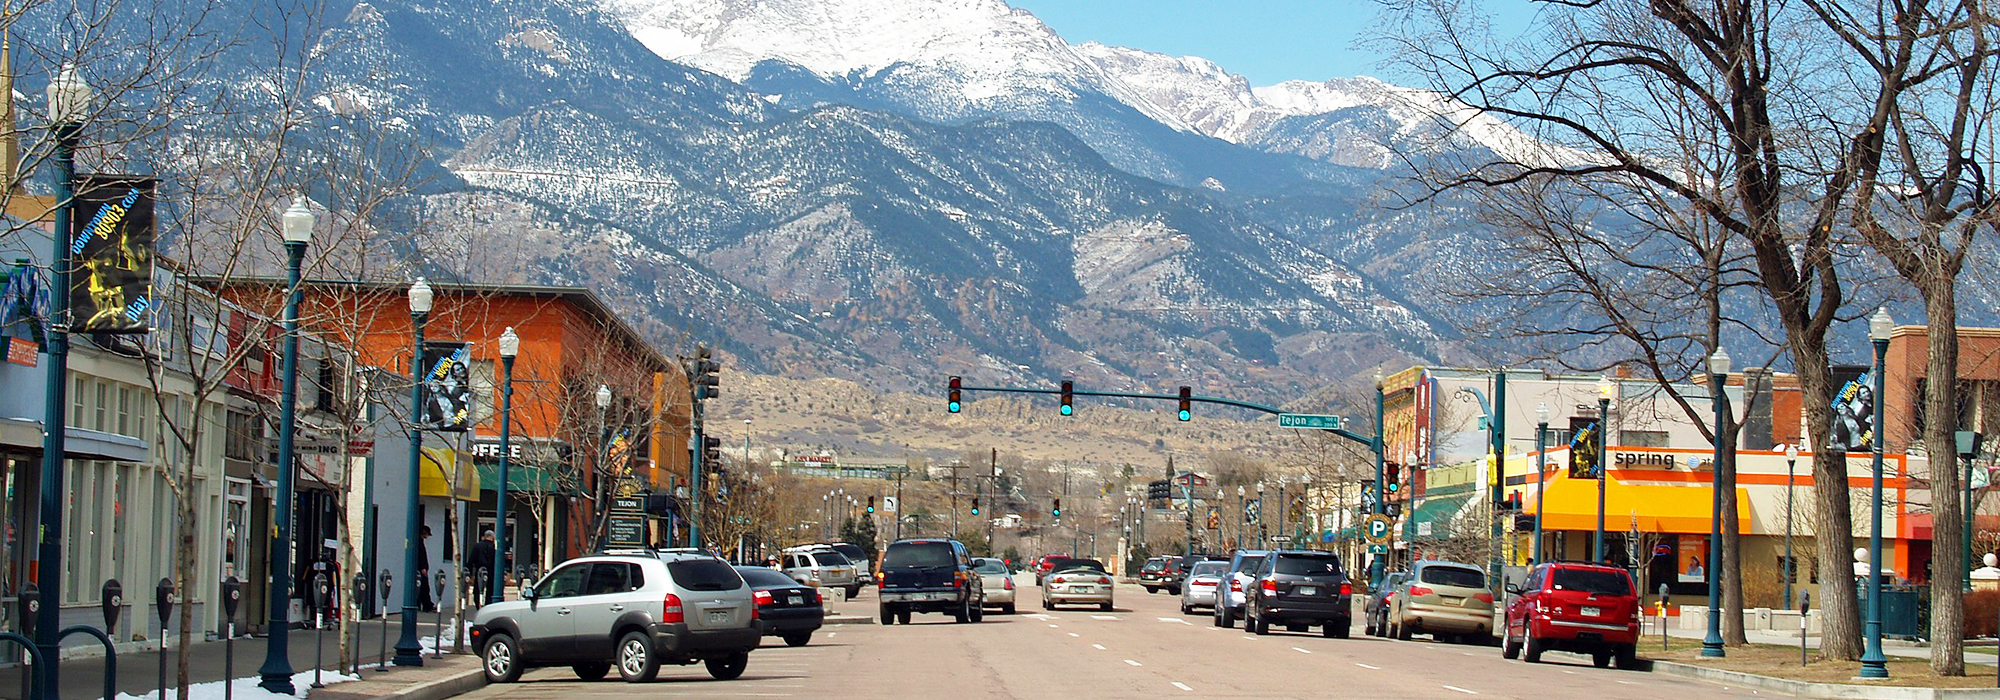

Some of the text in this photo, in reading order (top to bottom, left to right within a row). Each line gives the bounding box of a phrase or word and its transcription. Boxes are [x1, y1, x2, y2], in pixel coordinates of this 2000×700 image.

[72, 202, 112, 255] DOWNTOWN
[125, 295, 149, 322] play
[1281, 415, 1307, 426] Tejon
[1615, 451, 1674, 470] spring
[1372, 520, 1385, 536] P
